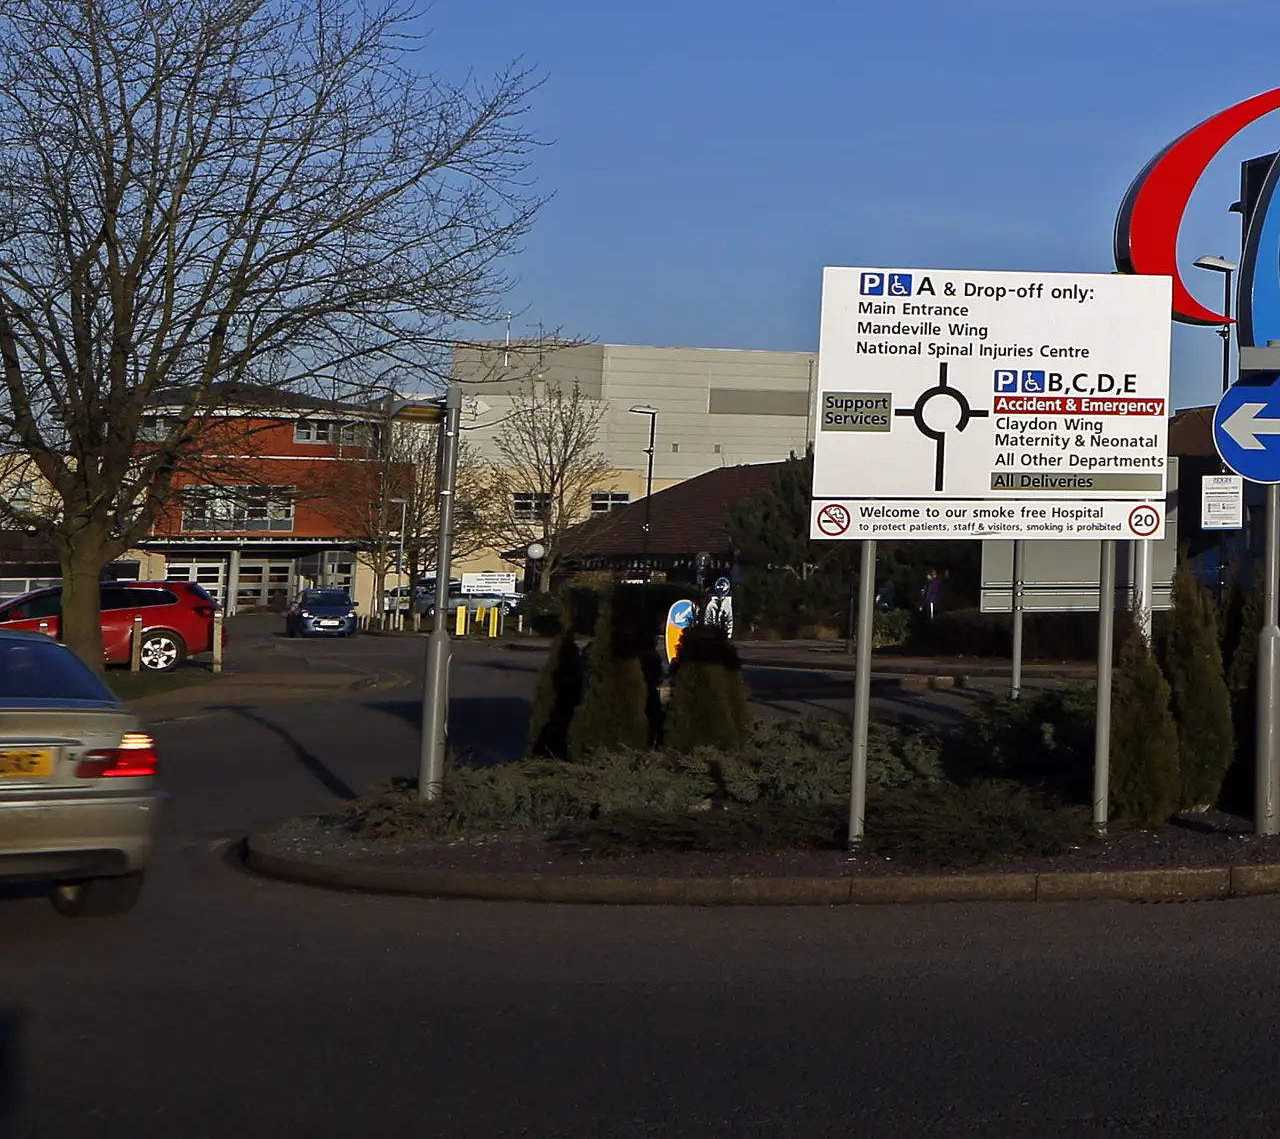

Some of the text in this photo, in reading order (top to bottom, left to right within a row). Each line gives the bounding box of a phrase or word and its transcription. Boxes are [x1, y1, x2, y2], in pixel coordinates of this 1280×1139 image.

[863, 275, 1094, 302] P A & Drop-off only:
[858, 302, 969, 316] Main Entrance
[857, 322, 988, 339] Mandeville Wing
[856, 341, 1090, 359] National Spinal Injuries Centre
[998, 372, 1137, 395] P B,C,D,E
[825, 396, 889, 411] Support
[996, 397, 1164, 415] Accident & Emergency
[825, 413, 888, 426] Services
[995, 417, 1103, 434] Claydon Wing
[995, 434, 1158, 450] Maternity & Neonatal
[994, 453, 1164, 469] All Other Departments
[994, 475, 1094, 488] All Deliveries
[859, 506, 920, 517] Welcome
[925, 508, 940, 517] to
[972, 507, 1015, 517] smoke
[1020, 507, 1047, 518] free
[1051, 507, 1104, 520] Hospital
[1133, 514, 1155, 526] 20
[872, 524, 906, 532] protect
[909, 523, 950, 532] patients,
[953, 523, 977, 531] staff
[978, 523, 986, 531] &
[986, 523, 1023, 533] visitors,
[1026, 523, 1064, 533] smoking
[1076, 523, 1122, 532] prohibited
